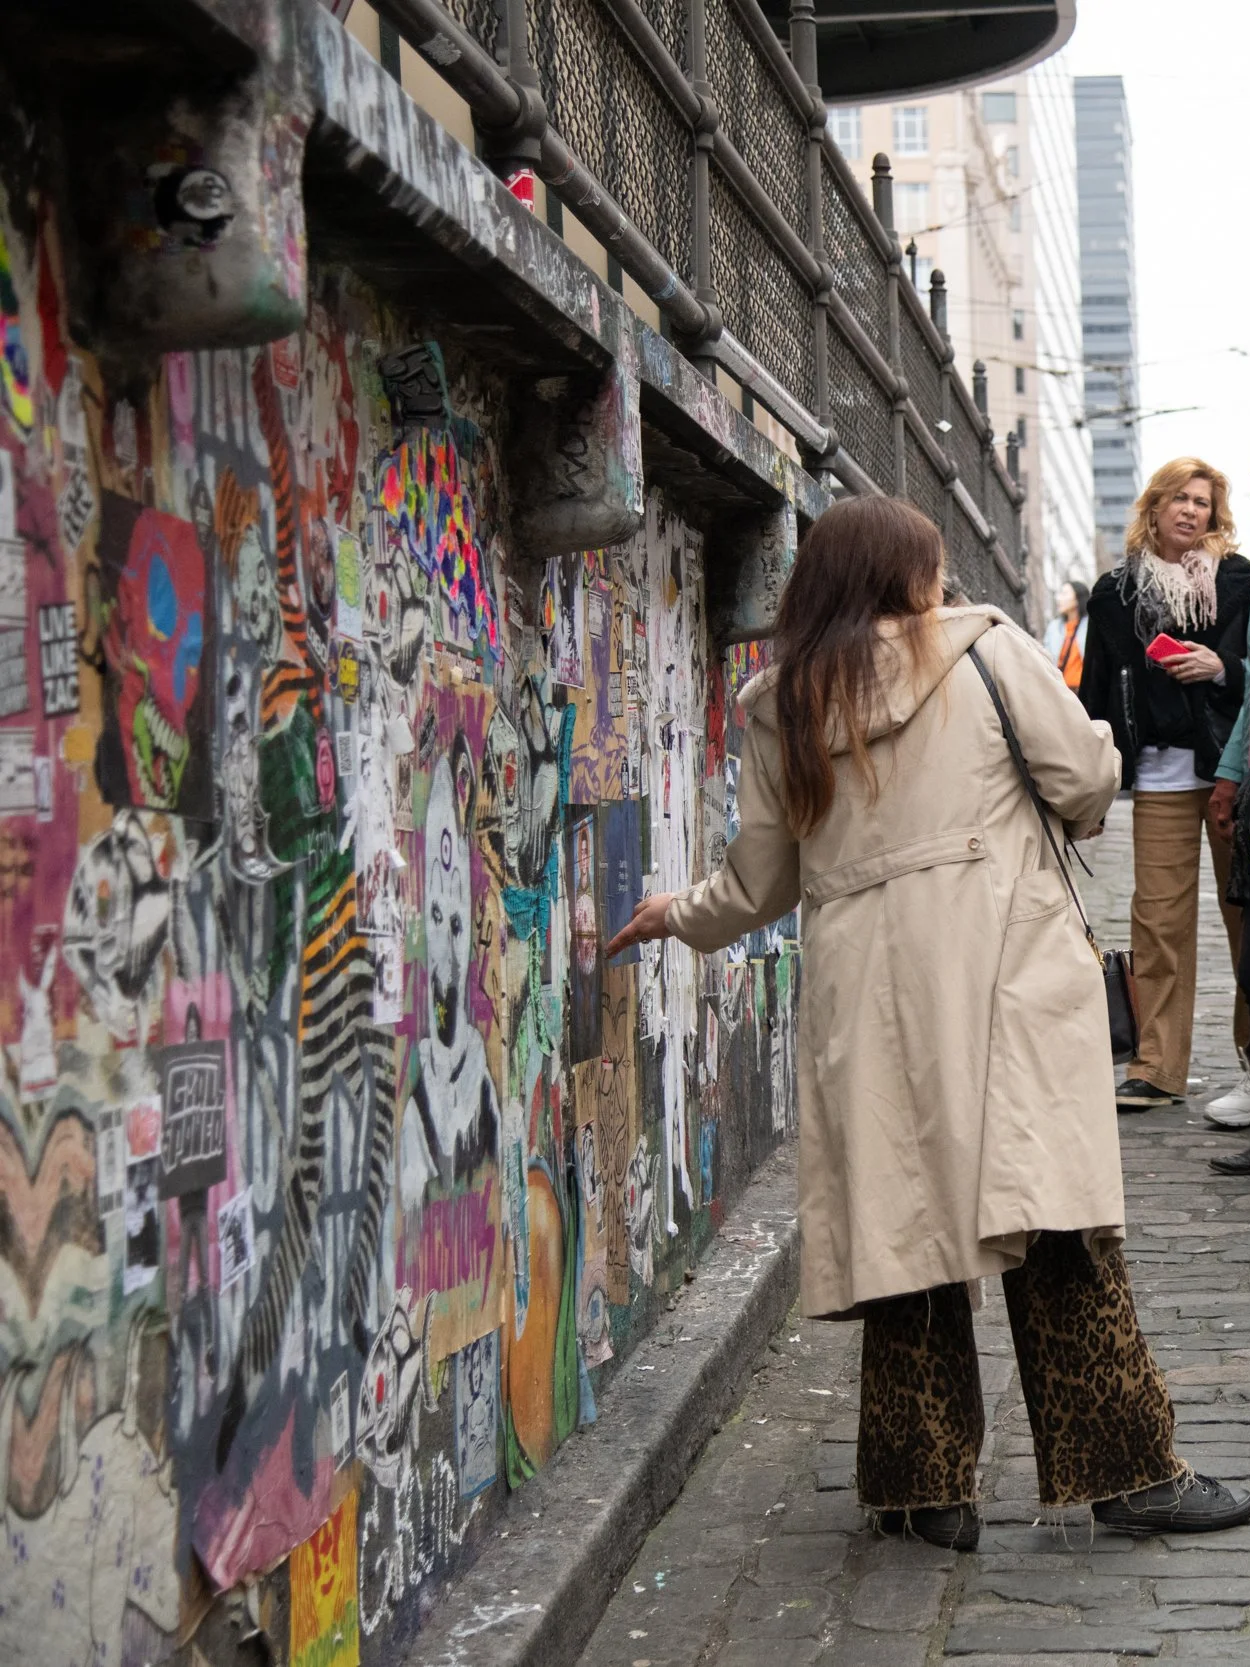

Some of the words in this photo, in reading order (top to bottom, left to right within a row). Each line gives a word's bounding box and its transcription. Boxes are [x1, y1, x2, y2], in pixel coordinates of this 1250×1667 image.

[39, 605, 77, 640] LIVE
[41, 640, 78, 676] LIKE
[44, 675, 79, 713] ZAC
